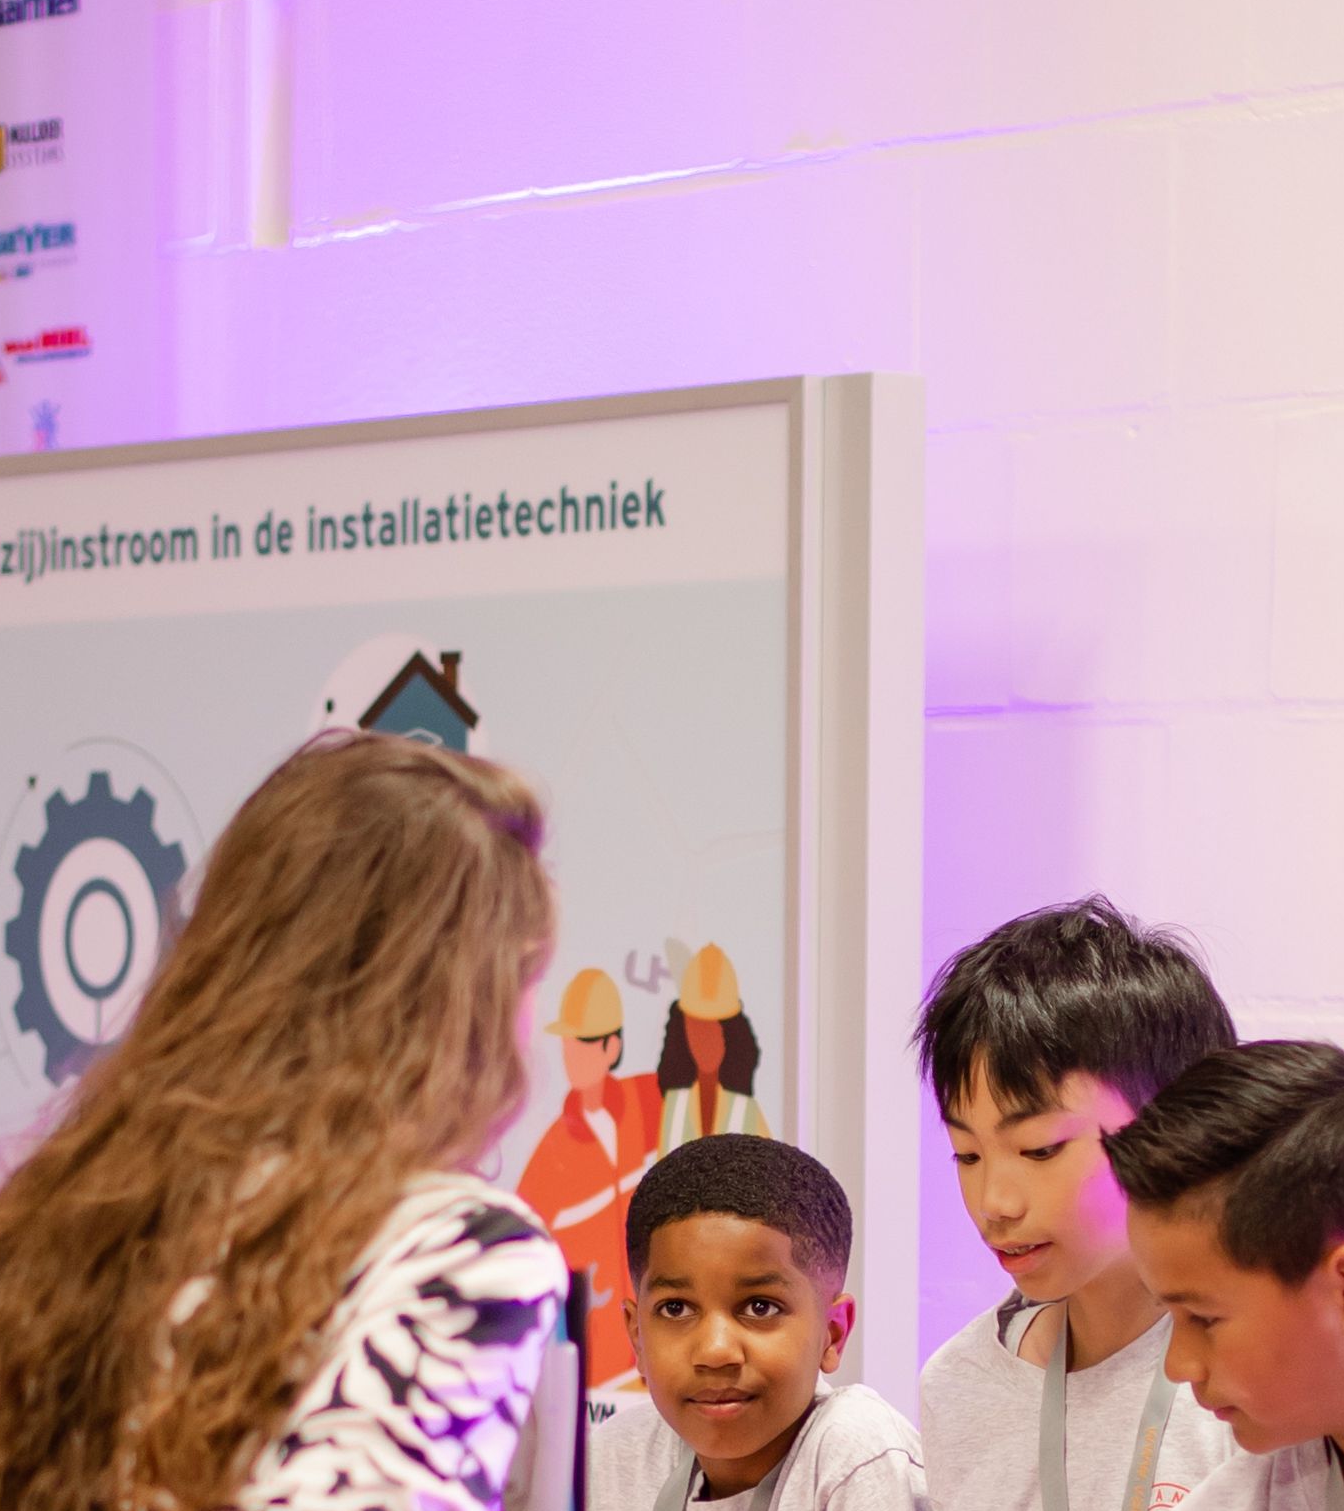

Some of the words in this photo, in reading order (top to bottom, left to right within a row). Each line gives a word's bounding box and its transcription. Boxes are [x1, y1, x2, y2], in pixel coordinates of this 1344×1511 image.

[212, 514, 241, 560] in
[254, 510, 293, 555] de
[307, 477, 667, 552] installatietechniek
